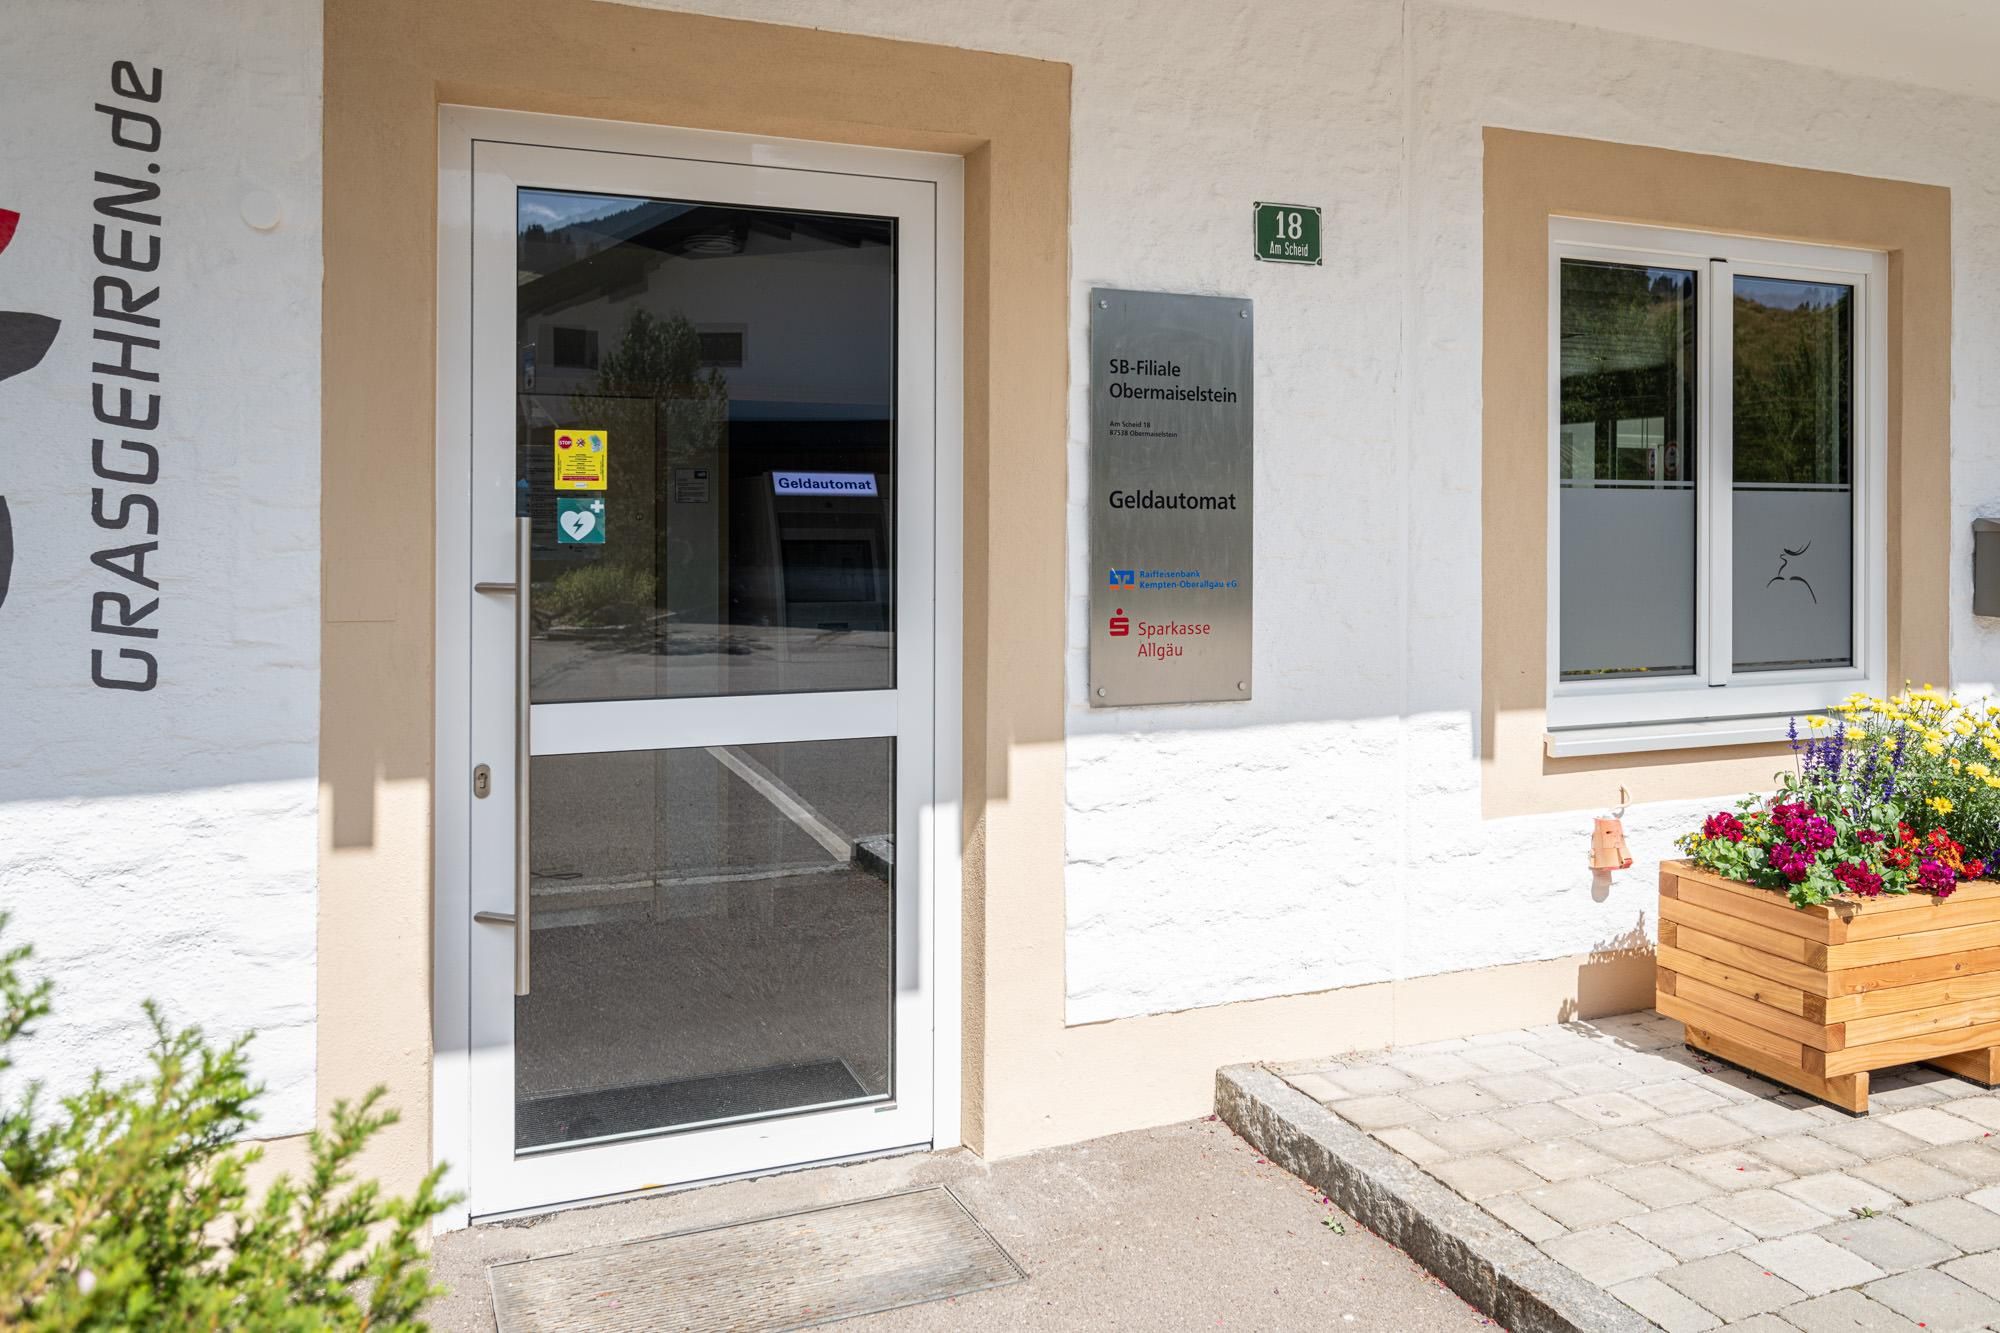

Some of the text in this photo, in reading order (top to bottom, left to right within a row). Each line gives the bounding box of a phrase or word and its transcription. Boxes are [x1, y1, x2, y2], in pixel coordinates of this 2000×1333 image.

[1276, 211, 1302, 240] 18
[1270, 241, 1309, 257] Am Scheid
[90, 59, 163, 692] GRASGEHREN.de
[1109, 358, 1181, 377] SB-Filiale
[1109, 383, 1237, 403] Obermaiselstein
[1129, 430, 1178, 438] Obermaiselstein
[778, 476, 873, 491] Geldautomat
[1109, 490, 1237, 510] Geldautomat
[1139, 570, 1201, 578] Raiffeisenbank
[1226, 580, 1238, 588] eG
[1138, 621, 1211, 639] Sparkasse
[1137, 642, 1184, 661] Allgäu
